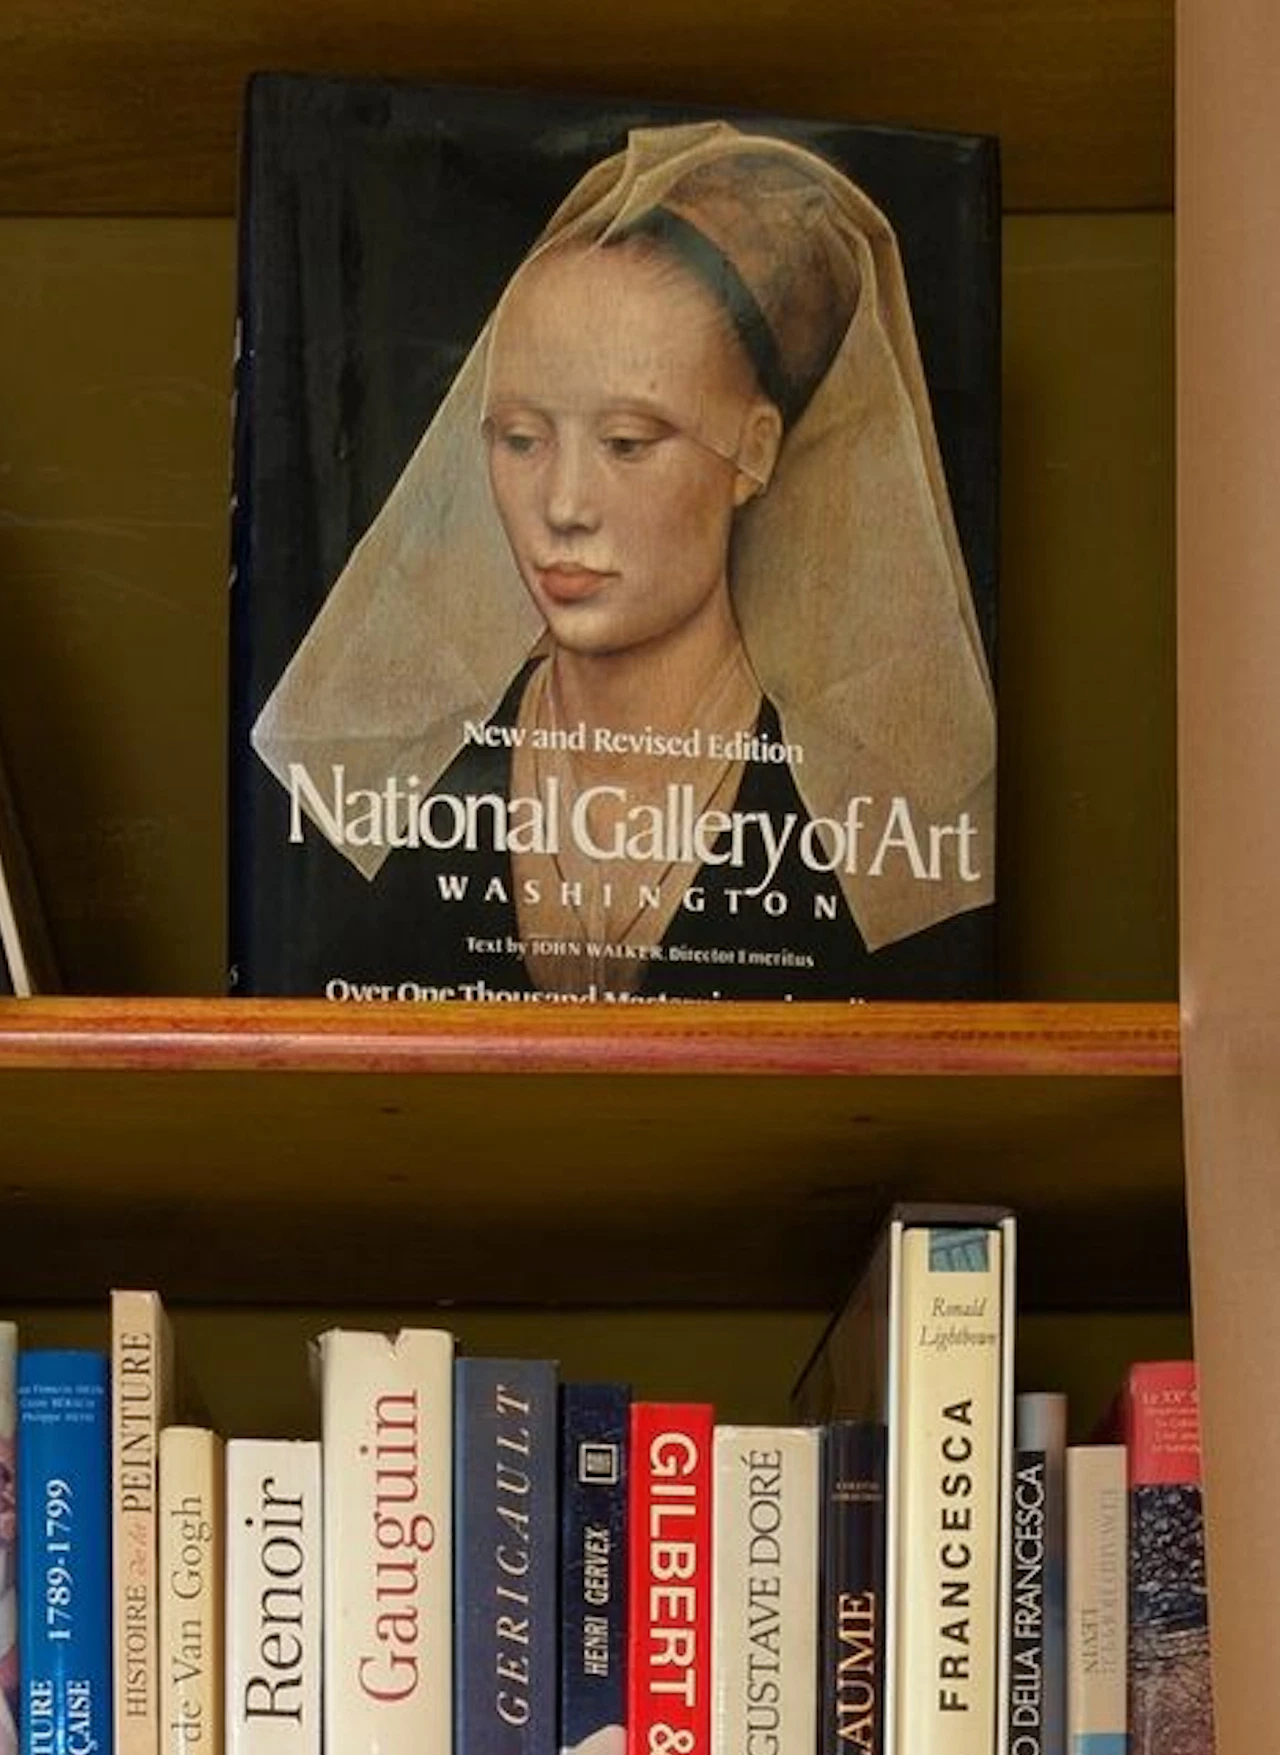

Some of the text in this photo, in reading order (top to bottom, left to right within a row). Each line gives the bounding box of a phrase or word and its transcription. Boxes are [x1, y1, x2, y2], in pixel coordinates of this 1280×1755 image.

[462, 718, 805, 766] New and Revised Edition
[285, 761, 981, 896] National Gallery of Art
[437, 874, 839, 921] WASHINGTON
[43, 1477, 75, 1641] 1789-1799
[170, 1494, 213, 1600] Gogh
[358, 1388, 436, 1704] Gauguin
[495, 1383, 531, 1727] GERICAULT
[647, 1431, 699, 1708] GILBERT
[739, 1446, 784, 1574] DORÉ
[937, 1399, 975, 1714] FRANCESCA
[243, 1476, 305, 1726] Renoir
[581, 1525, 611, 1678] HENRI GERVEX
